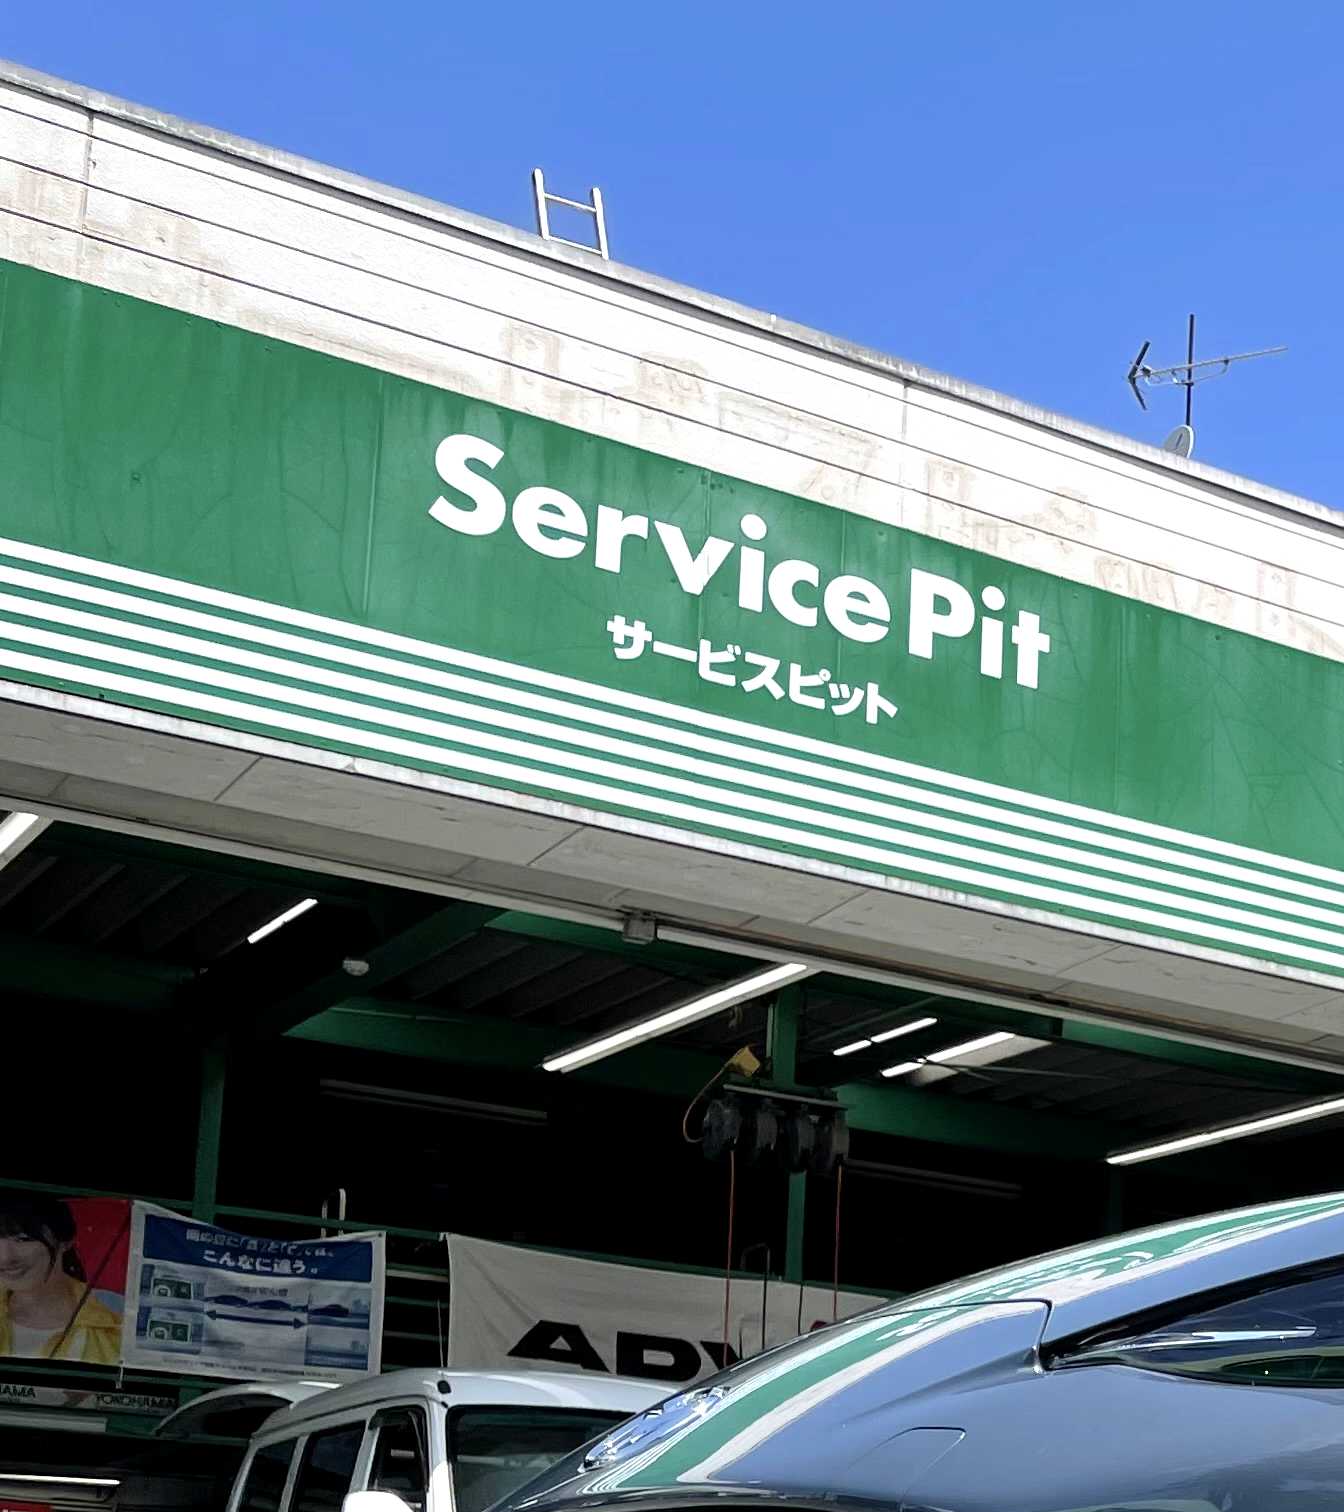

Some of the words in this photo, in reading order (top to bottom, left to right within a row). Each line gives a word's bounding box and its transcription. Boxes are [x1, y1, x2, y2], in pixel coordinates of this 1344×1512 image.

[428, 433, 891, 643] Service
[908, 567, 1051, 690] Pit
[606, 614, 898, 725] サービスピット
